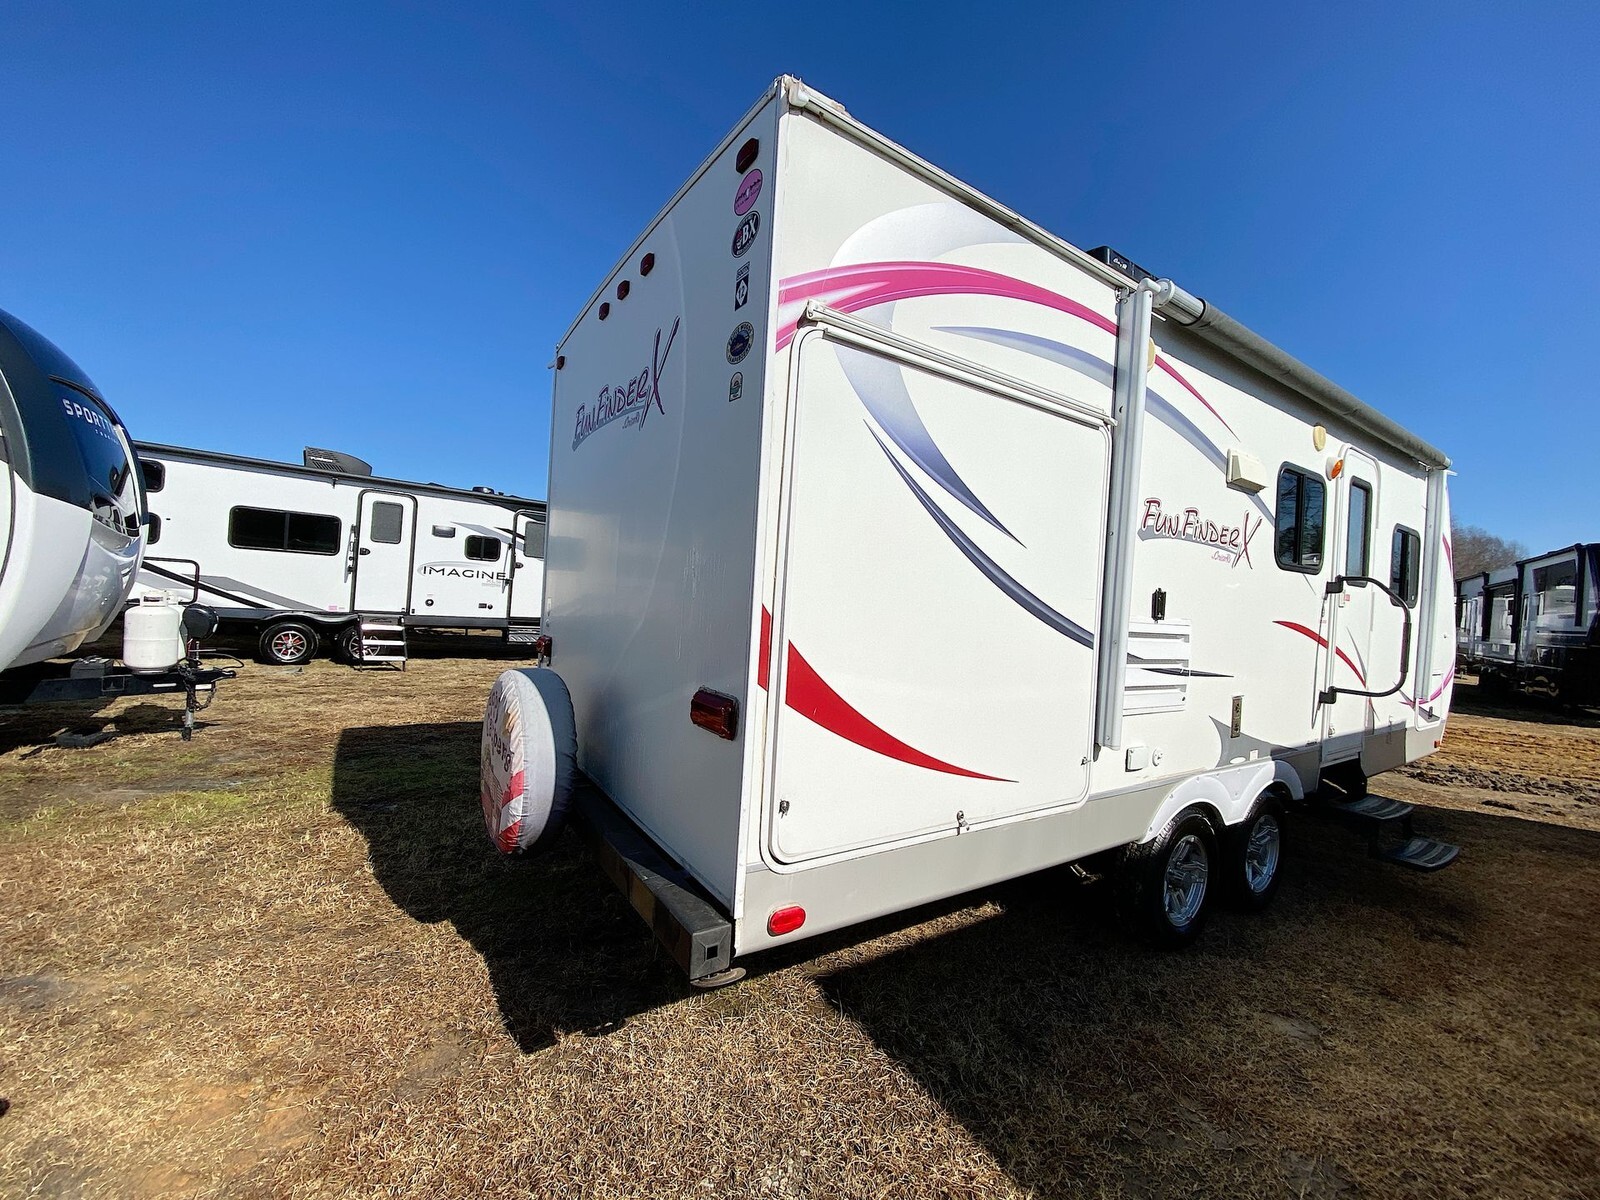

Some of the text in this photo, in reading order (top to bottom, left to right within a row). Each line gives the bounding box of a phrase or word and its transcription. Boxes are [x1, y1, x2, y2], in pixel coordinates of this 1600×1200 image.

[639, 316, 680, 431] X
[1232, 510, 1263, 569] X
[423, 566, 506, 581] IMAGINE
